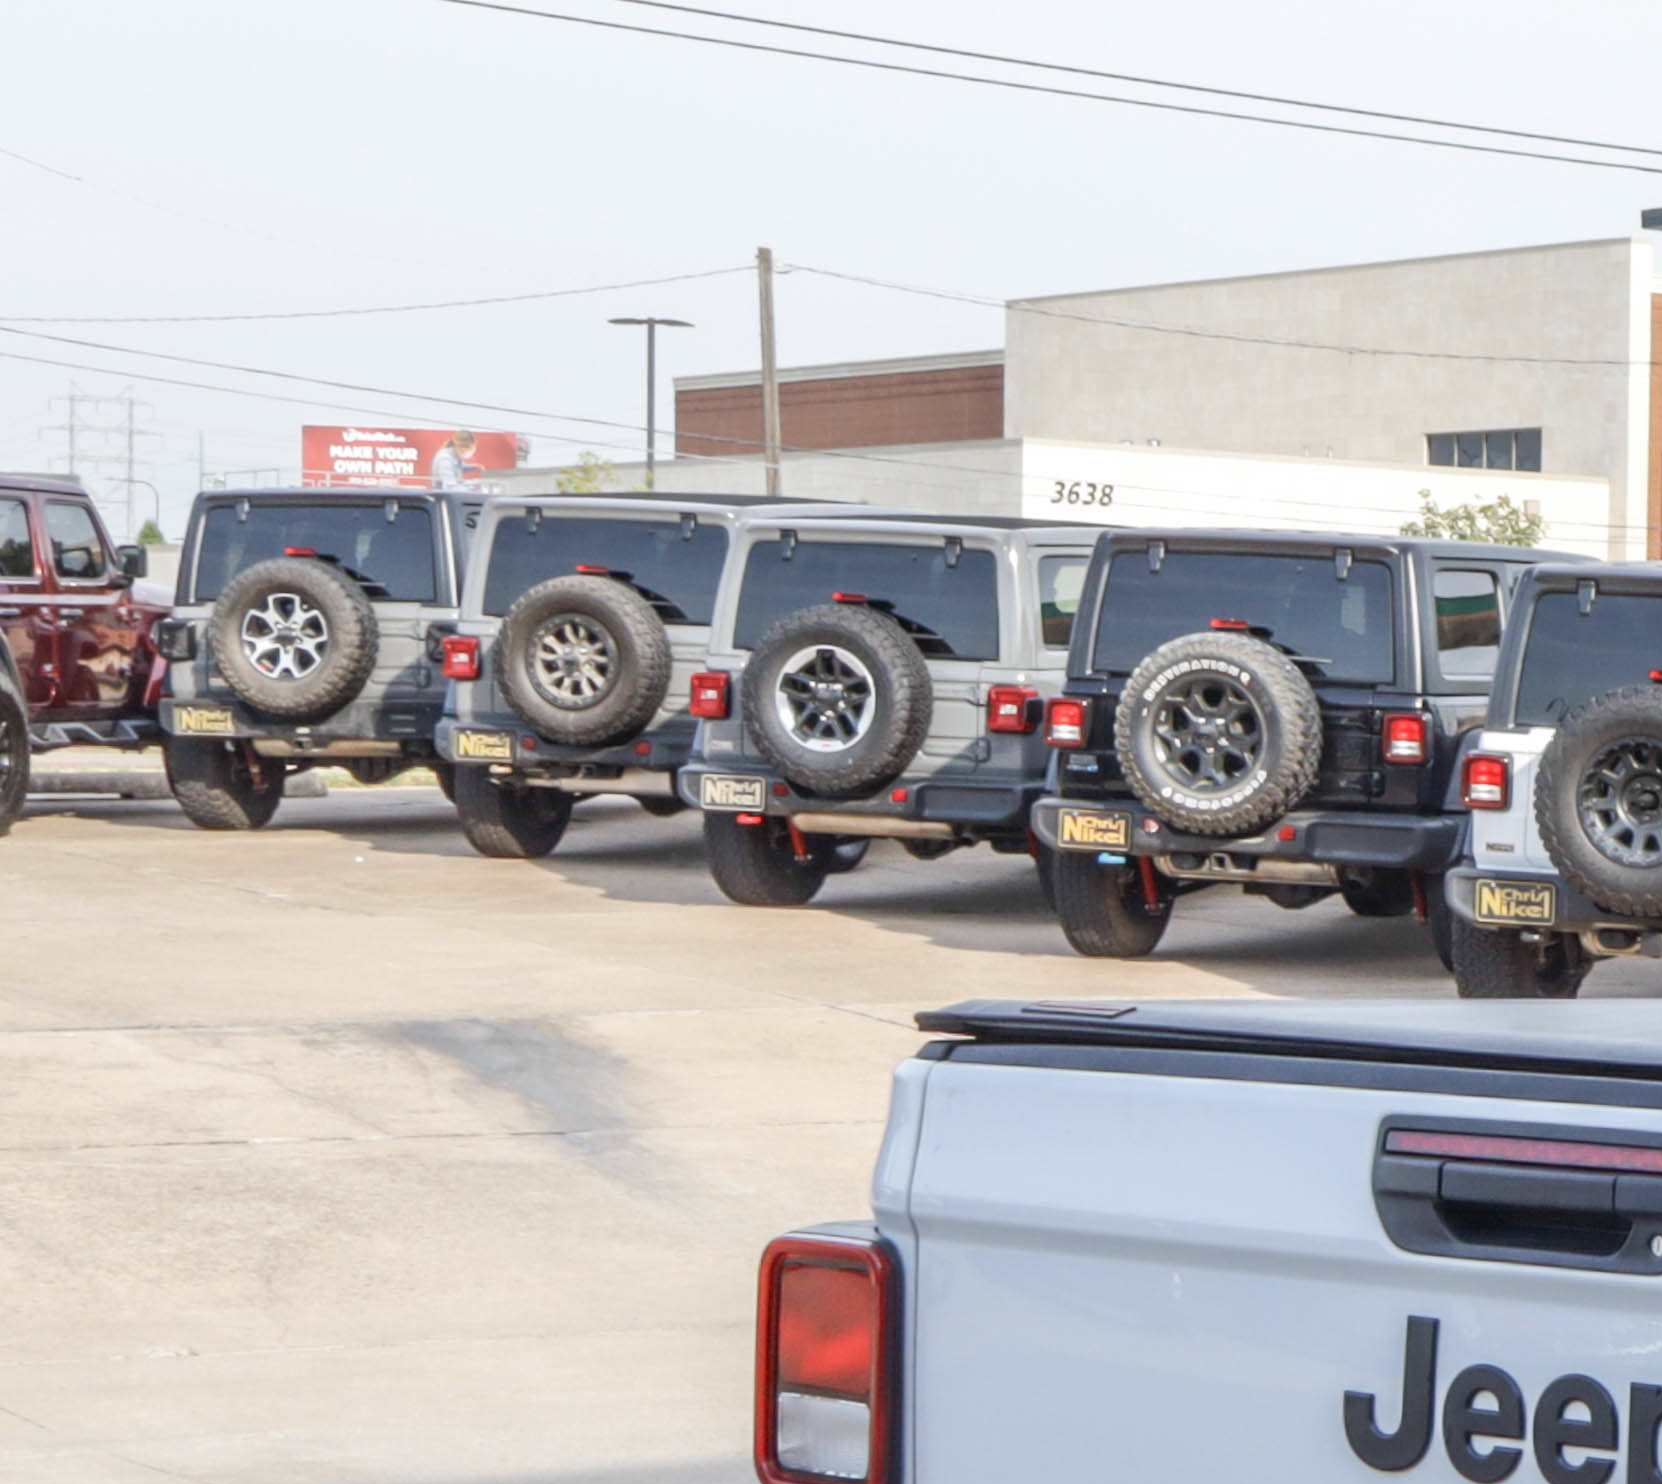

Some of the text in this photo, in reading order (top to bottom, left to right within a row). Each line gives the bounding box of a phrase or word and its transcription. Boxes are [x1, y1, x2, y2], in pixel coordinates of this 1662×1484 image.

[329, 446, 418, 461] MAKE YOUR
[333, 460, 415, 475] OWN PATH
[1051, 481, 1114, 506] 3638
[1481, 886, 1550, 919] Nikel
